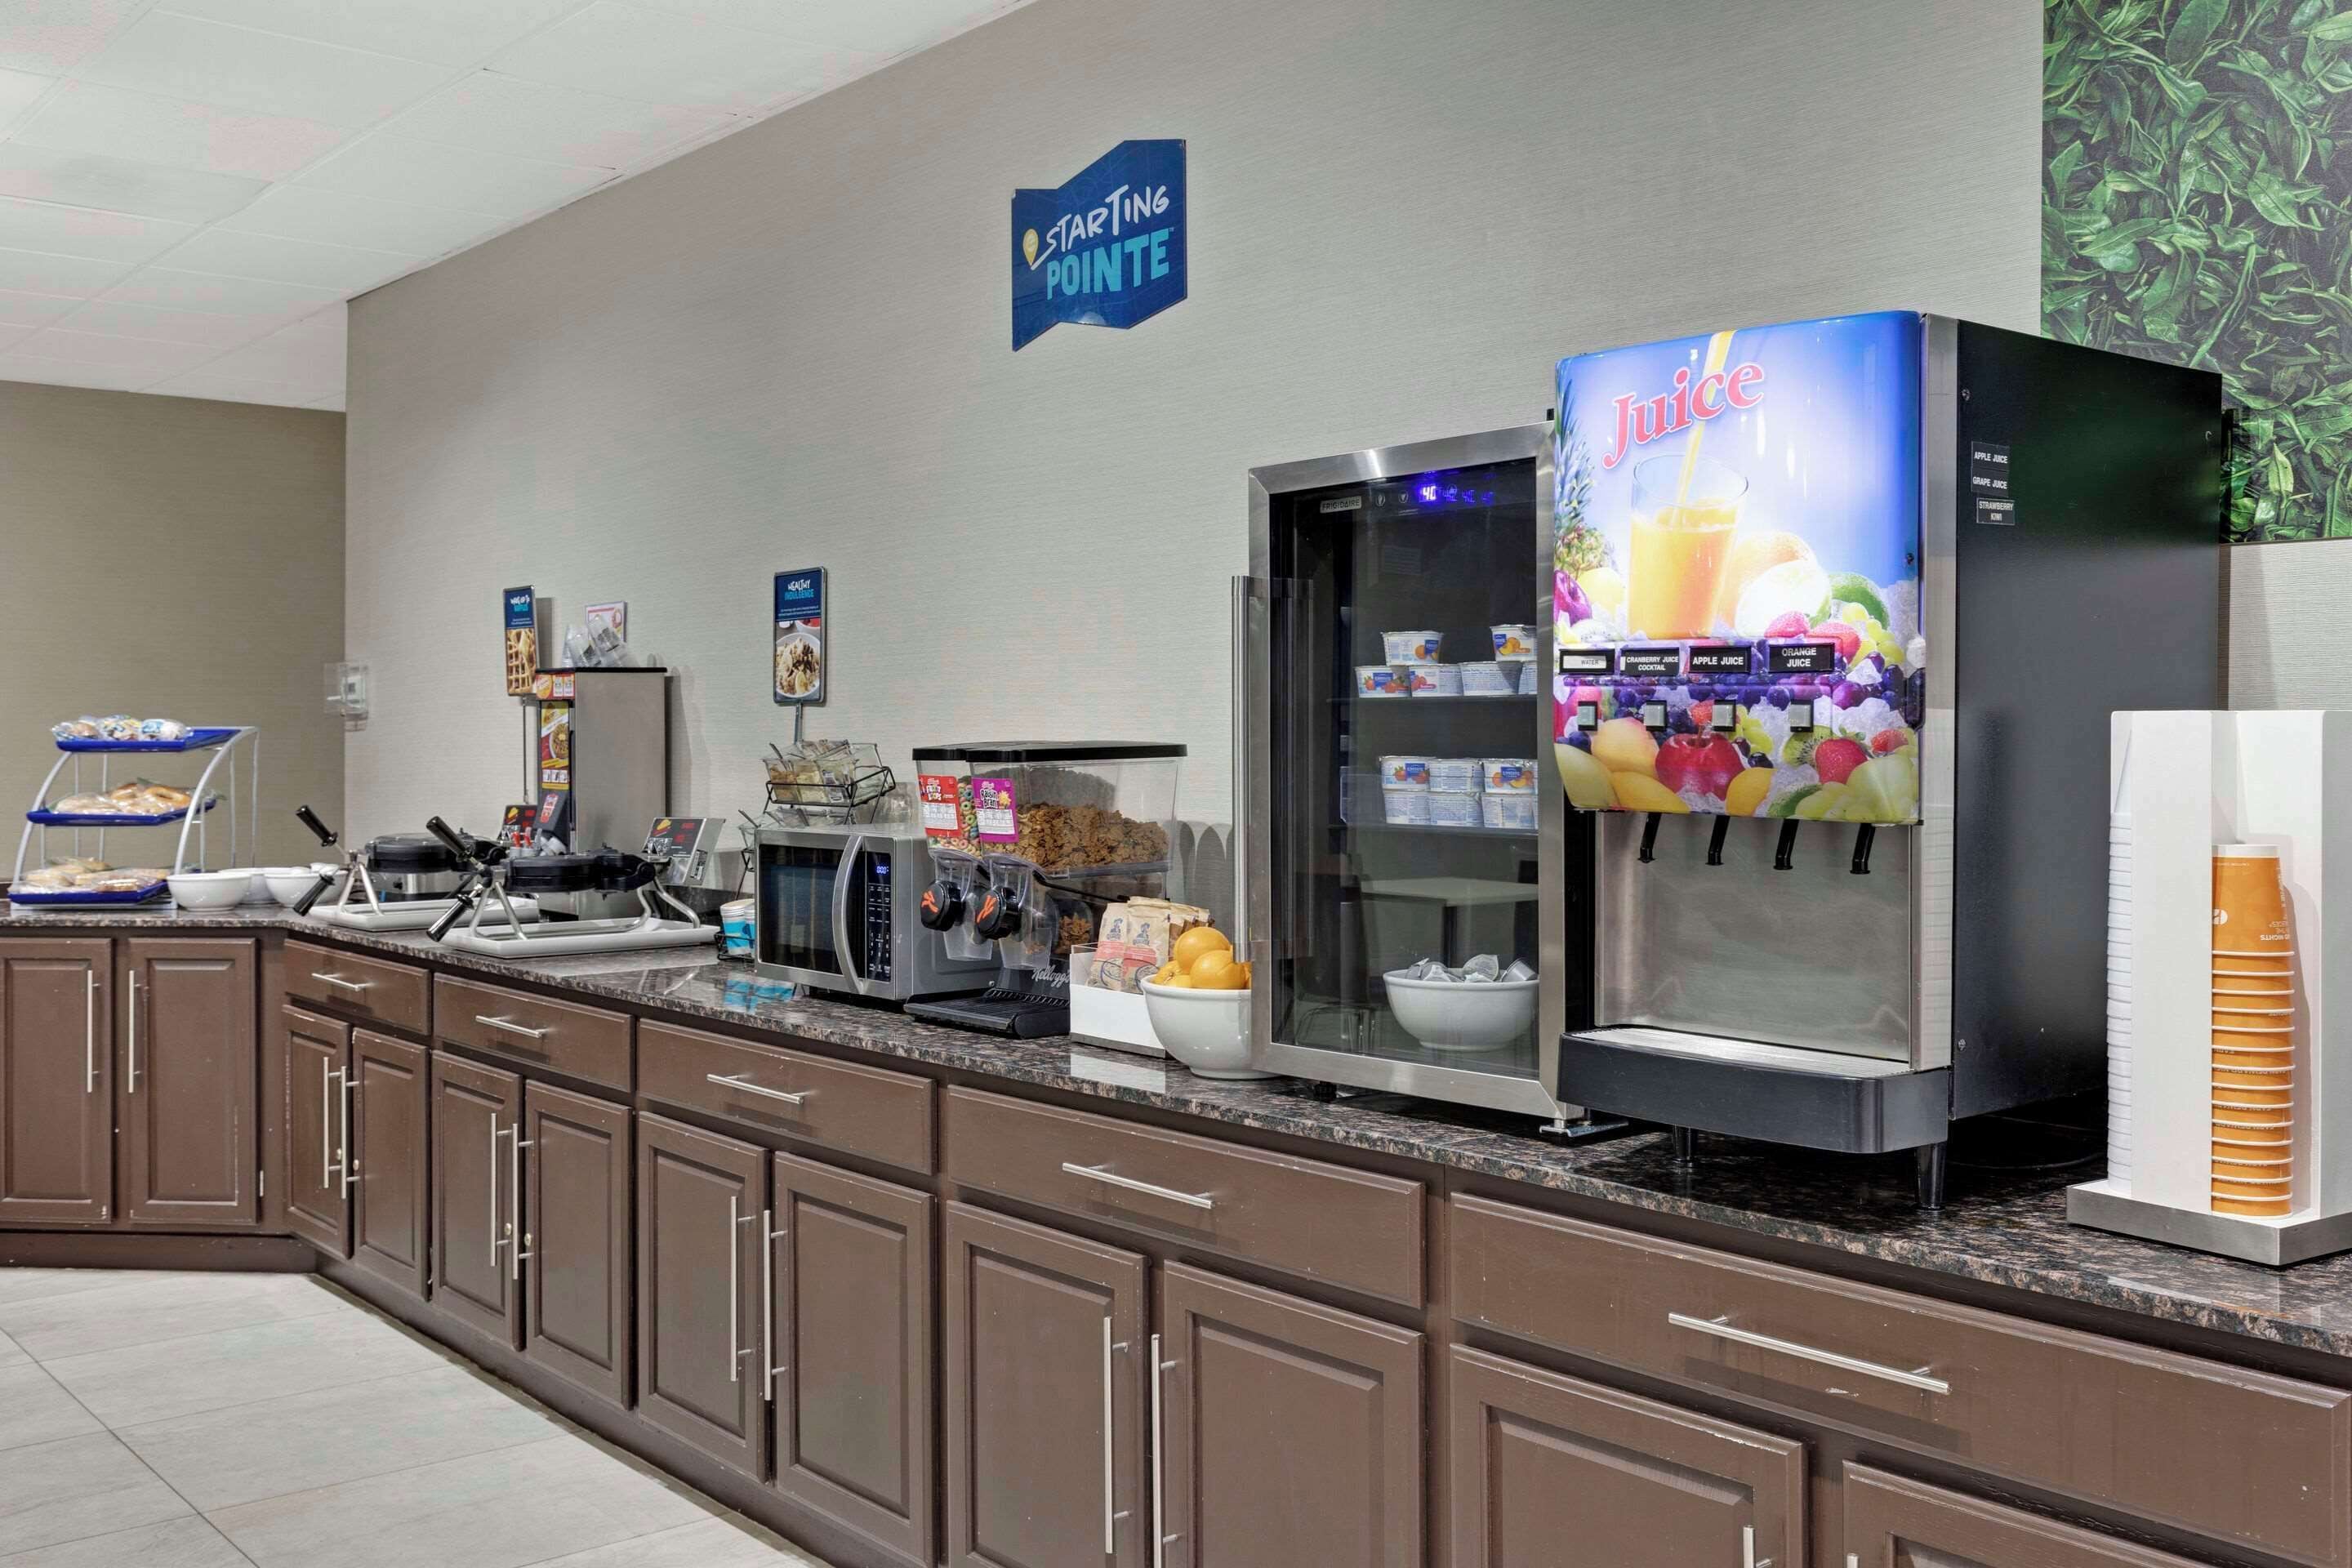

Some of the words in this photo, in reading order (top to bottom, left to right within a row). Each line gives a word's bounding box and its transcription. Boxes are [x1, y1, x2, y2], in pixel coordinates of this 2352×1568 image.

[1031, 185, 1170, 270] STARTING
[1047, 228, 1169, 301] POINTE
[1601, 362, 1764, 470] Juice
[1974, 451, 1991, 461] APPLE
[1993, 454, 2008, 464] JUICE
[1972, 476, 1991, 487] GRAPE
[1993, 479, 2007, 489] JUICE
[1322, 497, 1360, 510] FRIGIDAIRE
[1979, 501, 2014, 510] STRAWBERRY
[787, 579, 811, 591] HEALTHY
[1781, 647, 1817, 657] ORANGE
[1692, 656, 1717, 665] APPLE
[1720, 657, 1744, 666] JUICE
[1786, 658, 1811, 667] JUICE
